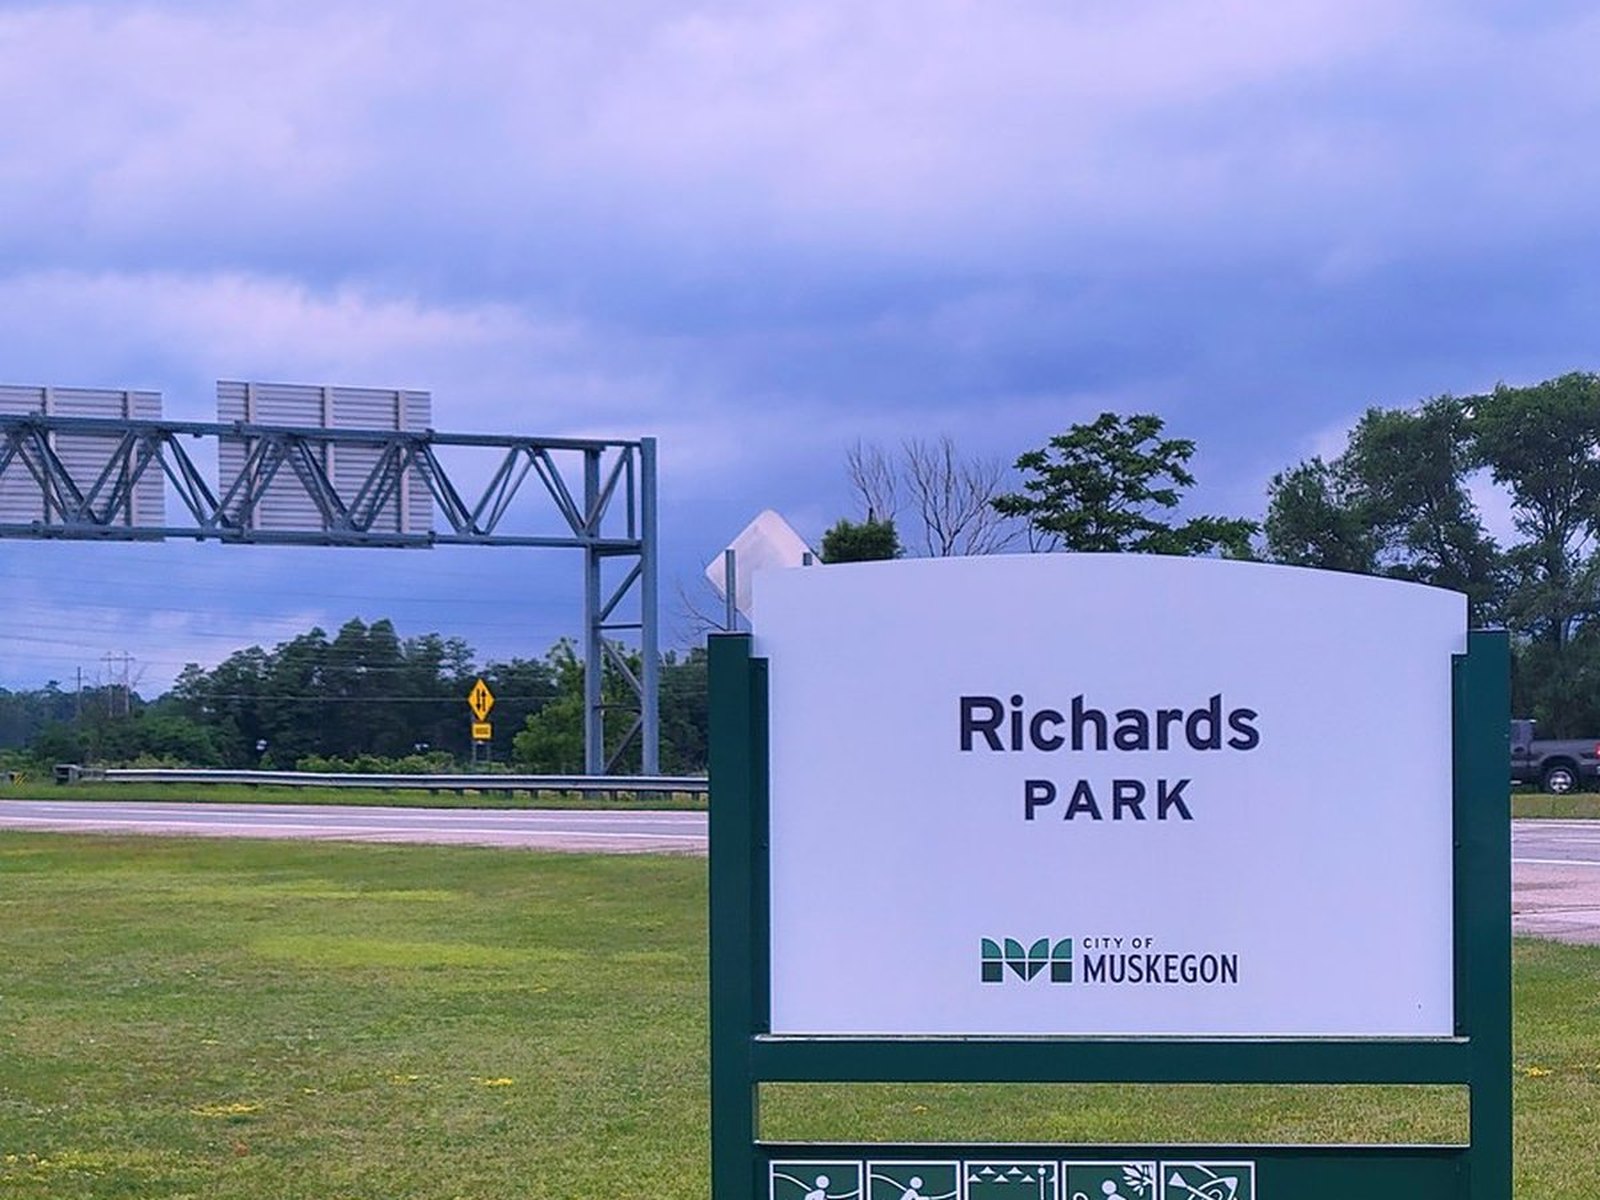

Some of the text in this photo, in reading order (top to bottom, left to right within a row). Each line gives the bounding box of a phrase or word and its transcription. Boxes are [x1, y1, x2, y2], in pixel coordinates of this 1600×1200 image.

[960, 694, 1259, 752] Richards
[1025, 779, 1193, 820] PARK
[1083, 938, 1152, 949] CITY OF
[1084, 954, 1237, 983] MUSKEGON
